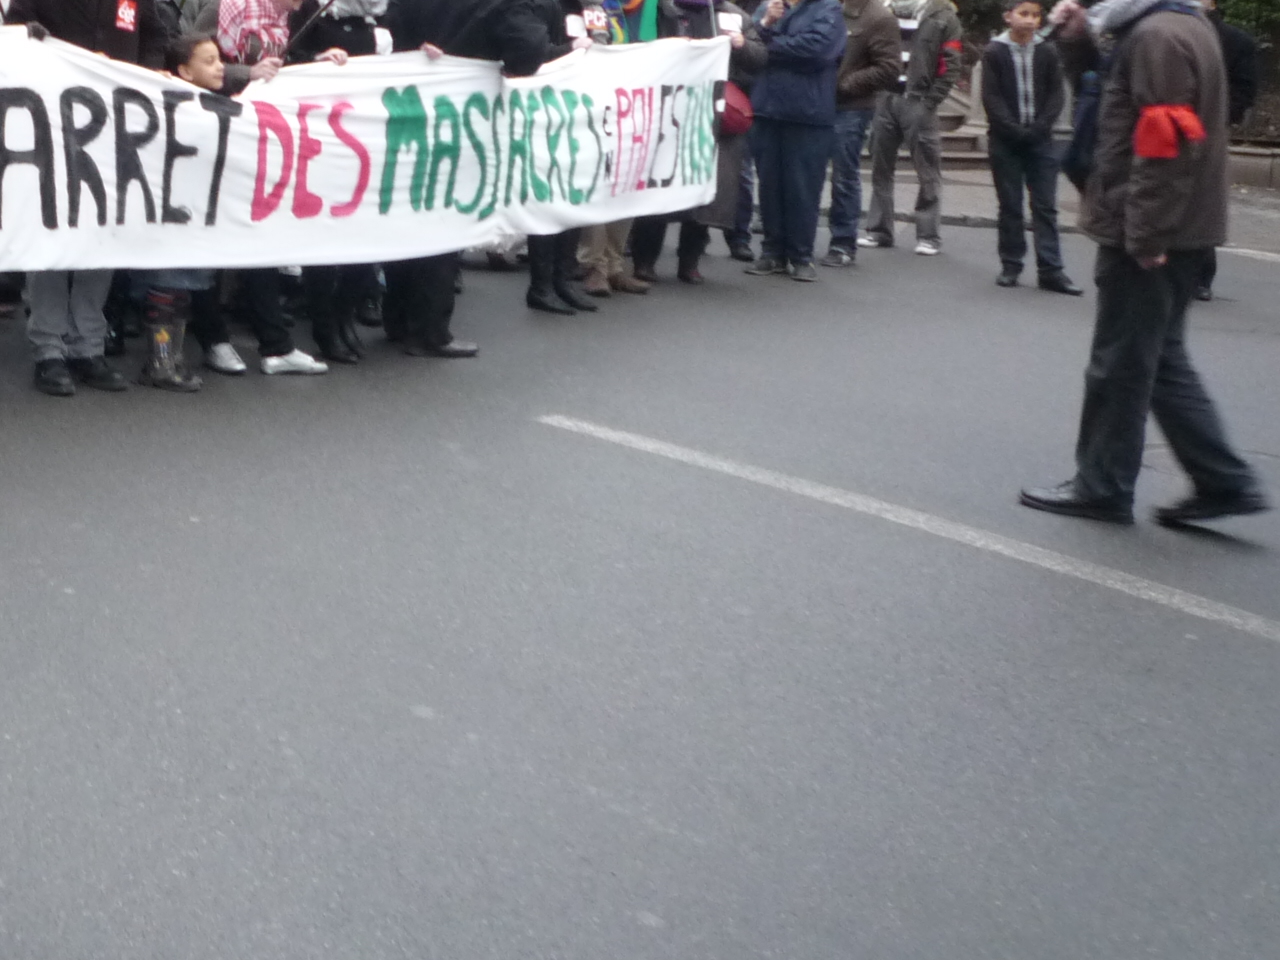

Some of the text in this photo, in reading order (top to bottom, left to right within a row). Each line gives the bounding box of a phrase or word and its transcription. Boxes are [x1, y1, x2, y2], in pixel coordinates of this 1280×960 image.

[584, 9, 608, 26] PCF
[250, 100, 370, 221] DES
[379, 84, 602, 220] MASSACRES
